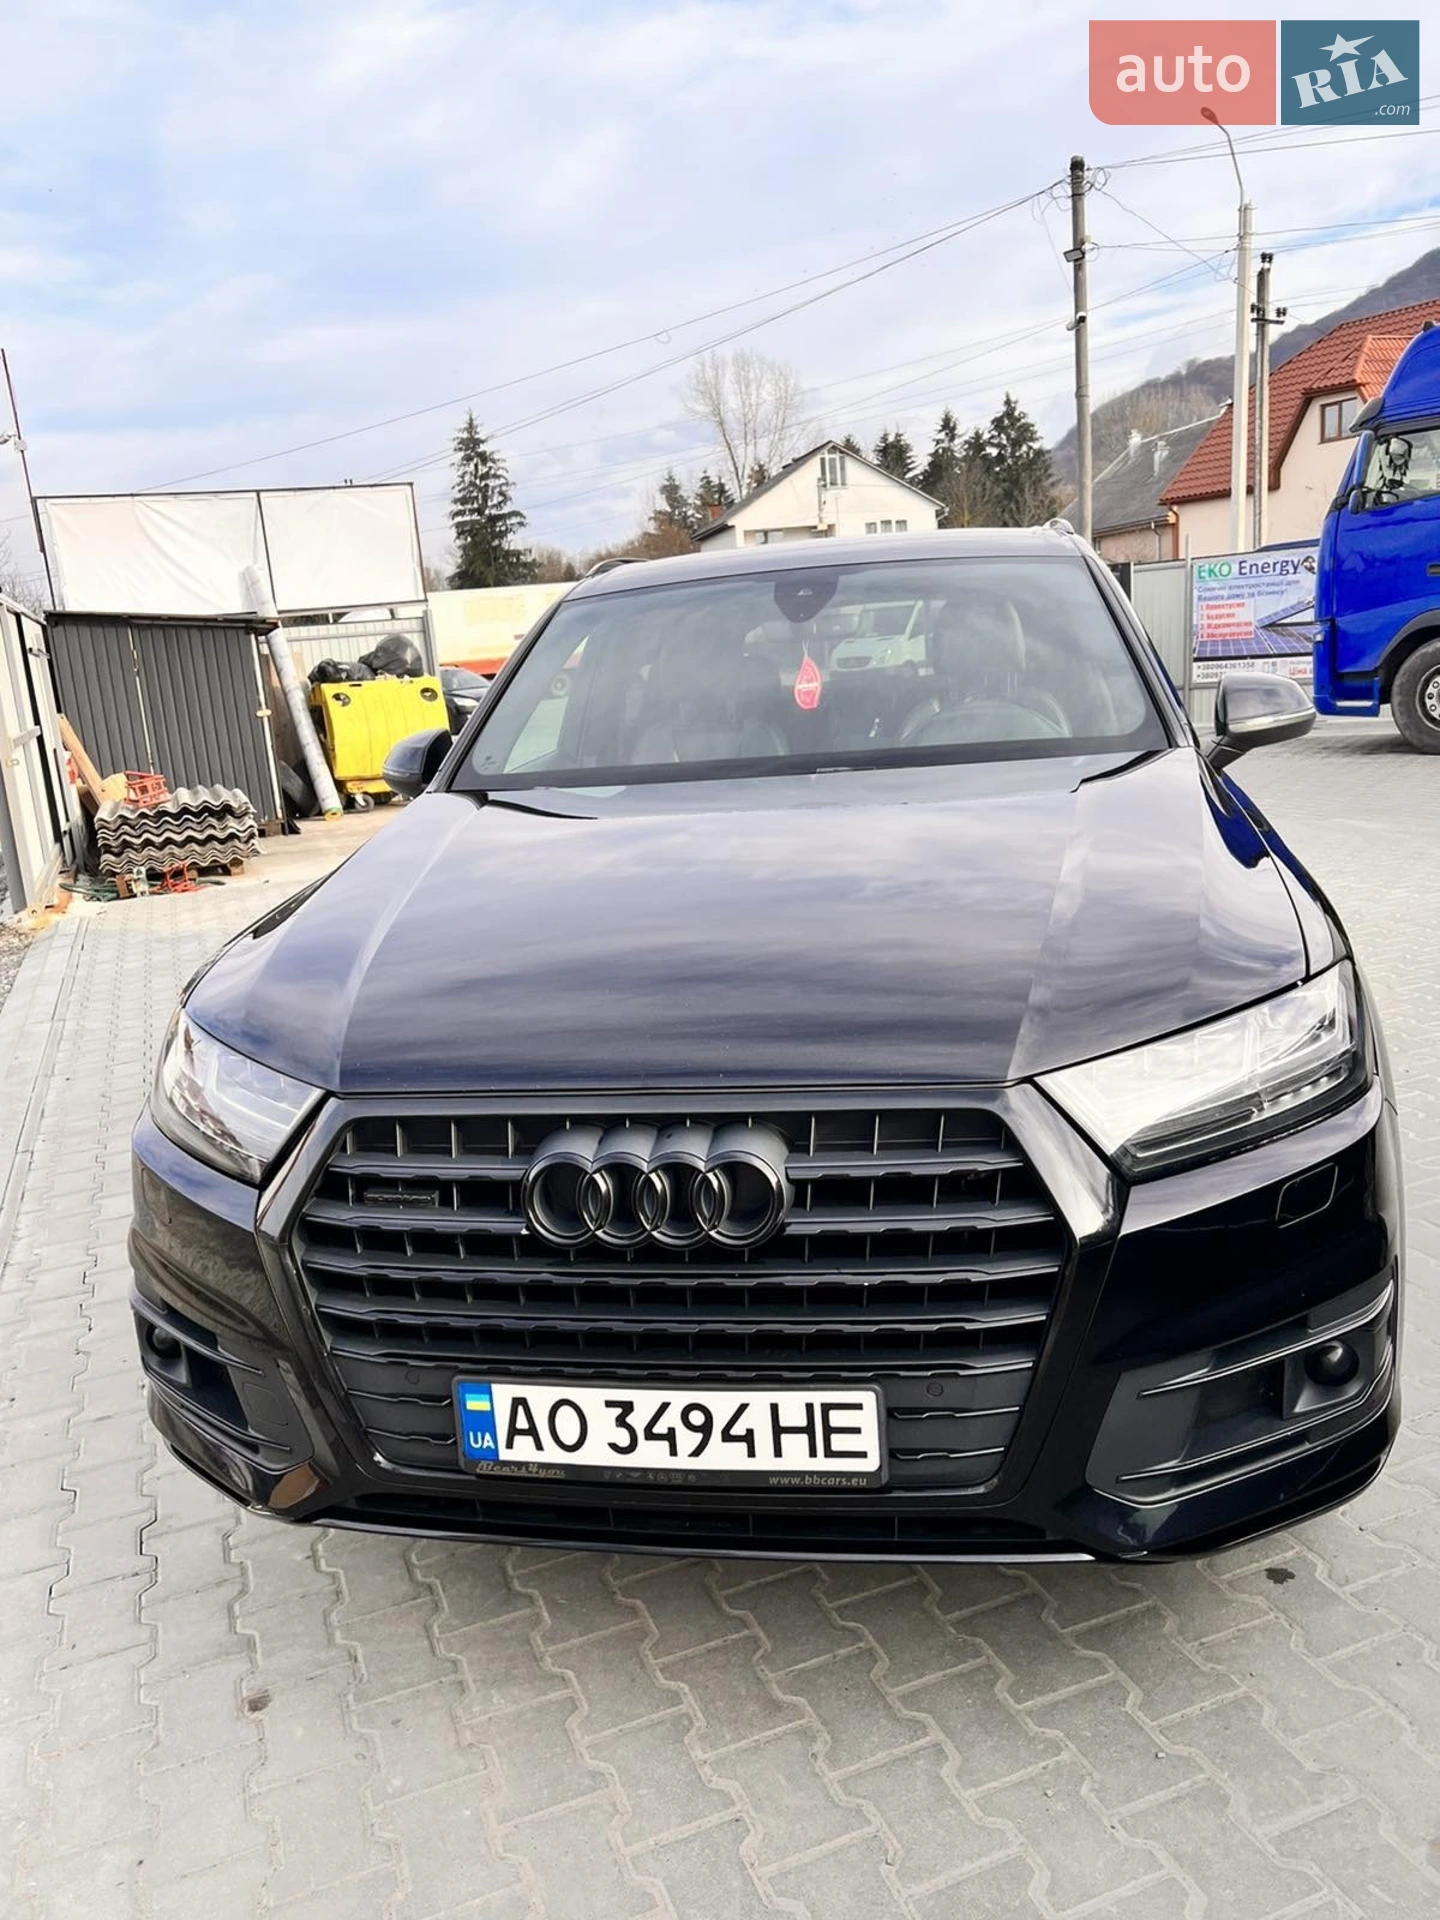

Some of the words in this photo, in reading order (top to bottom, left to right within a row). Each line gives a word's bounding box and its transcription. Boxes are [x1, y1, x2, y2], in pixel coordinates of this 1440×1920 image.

[1197, 562, 1232, 579] EKO
[1238, 559, 1300, 576] Energy
[505, 1396, 588, 1453] AO
[604, 1400, 756, 1458] 3494
[770, 1402, 868, 1459] HE
[469, 1431, 495, 1450] UA
[768, 1474, 867, 1486] www.bbcars.eu
